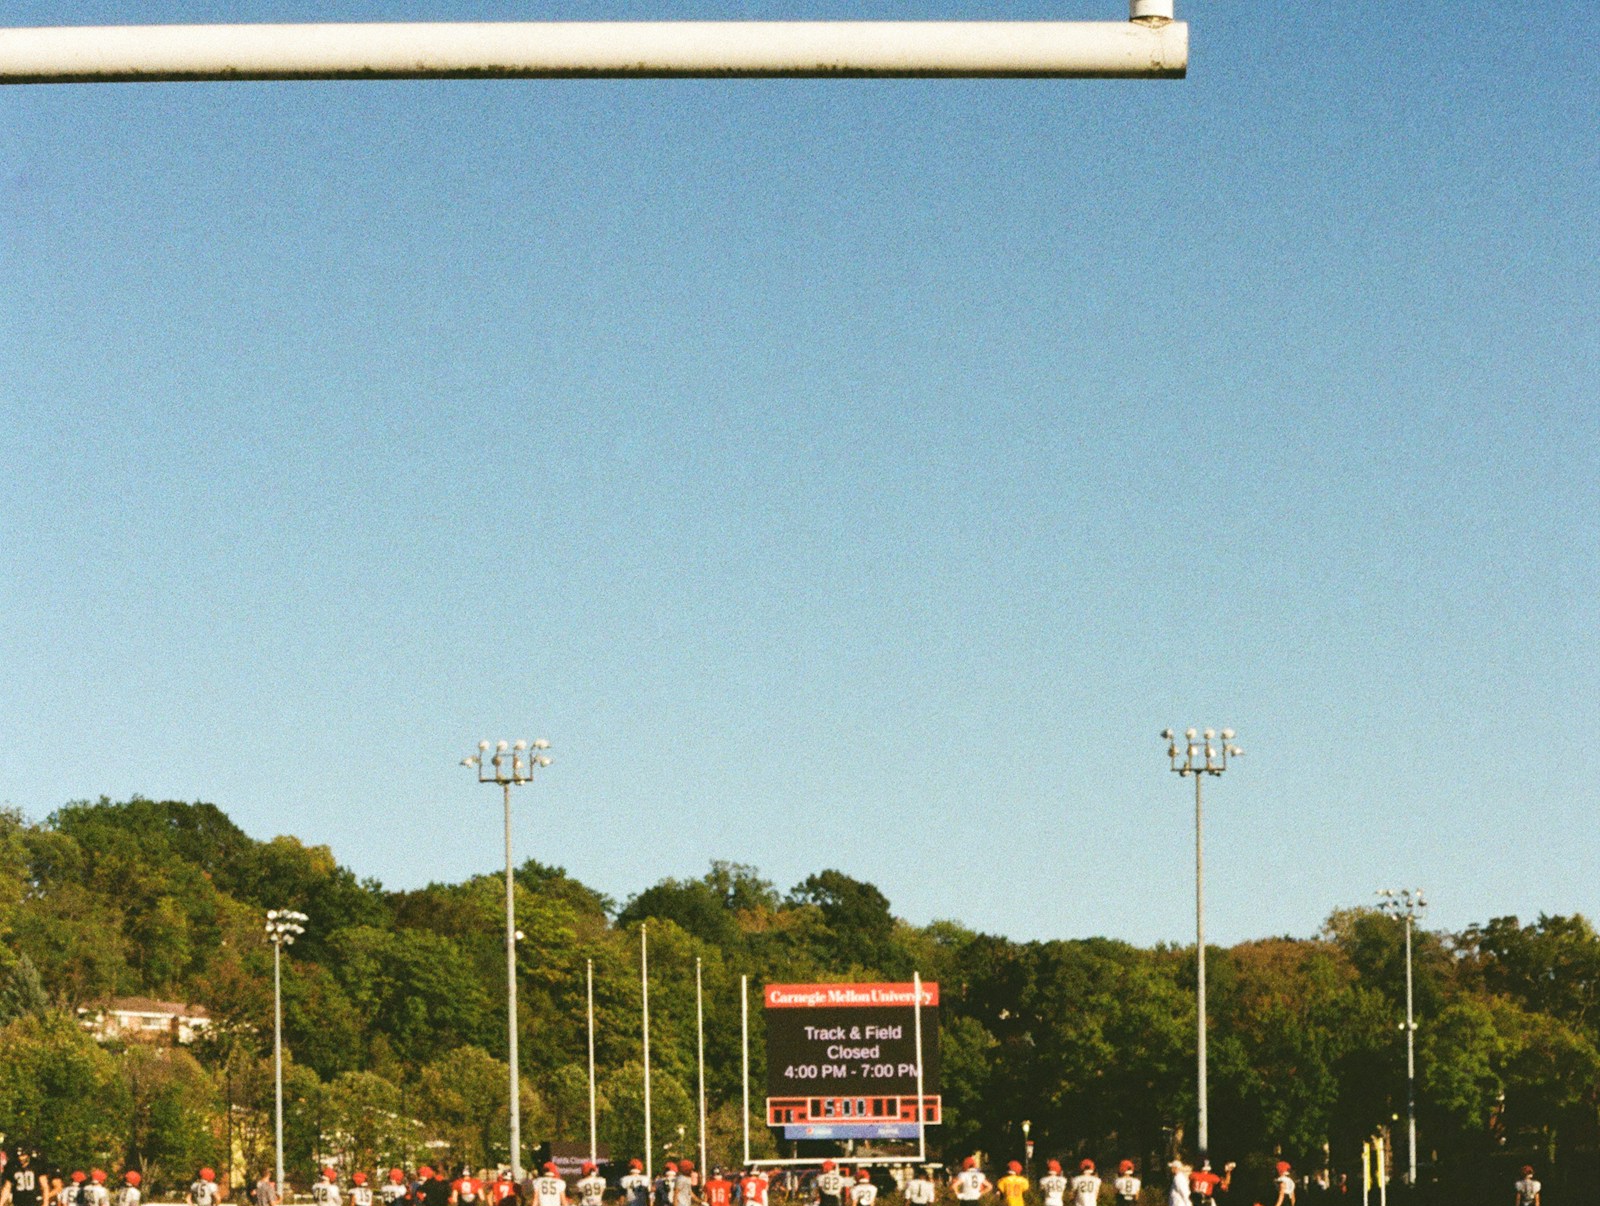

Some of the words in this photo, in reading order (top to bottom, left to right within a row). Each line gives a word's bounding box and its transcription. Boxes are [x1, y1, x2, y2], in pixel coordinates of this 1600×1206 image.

[770, 990, 827, 1006] Carnegie
[828, 989, 870, 1004] Mellon
[871, 988, 933, 1005] Universty
[804, 1026, 846, 1040] Track
[849, 1026, 861, 1040] &
[865, 1025, 902, 1040] Field
[827, 1045, 880, 1059] Closed
[784, 1065, 818, 1079] 4:00
[821, 1064, 847, 1078] PM
[861, 1064, 894, 1078] 7:00
[14, 1170, 35, 1191] 30
[500, 1185, 509, 1198] 7
